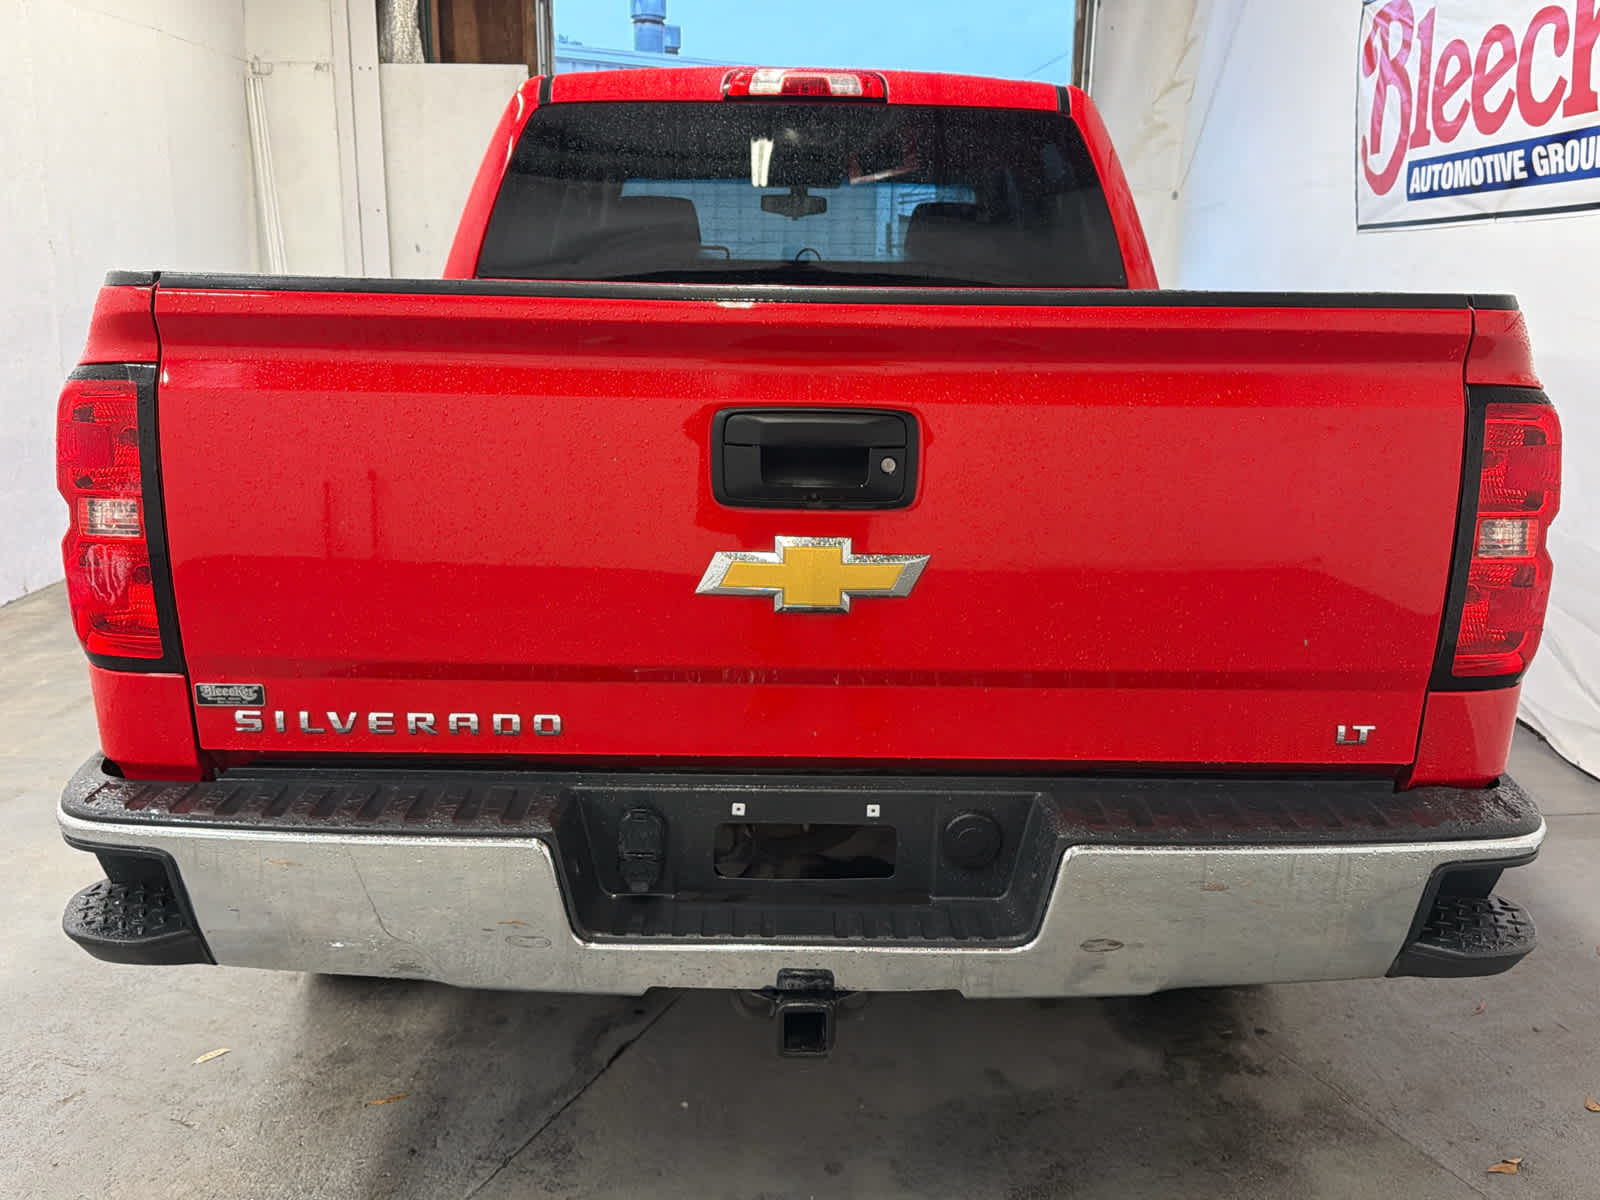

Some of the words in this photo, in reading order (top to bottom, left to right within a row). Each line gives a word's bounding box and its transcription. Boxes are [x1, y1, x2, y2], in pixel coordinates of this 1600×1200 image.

[1409, 148, 1529, 194] AUTOMOTIVE
[234, 710, 562, 736] SILVERADO
[1336, 725, 1376, 745] LT
